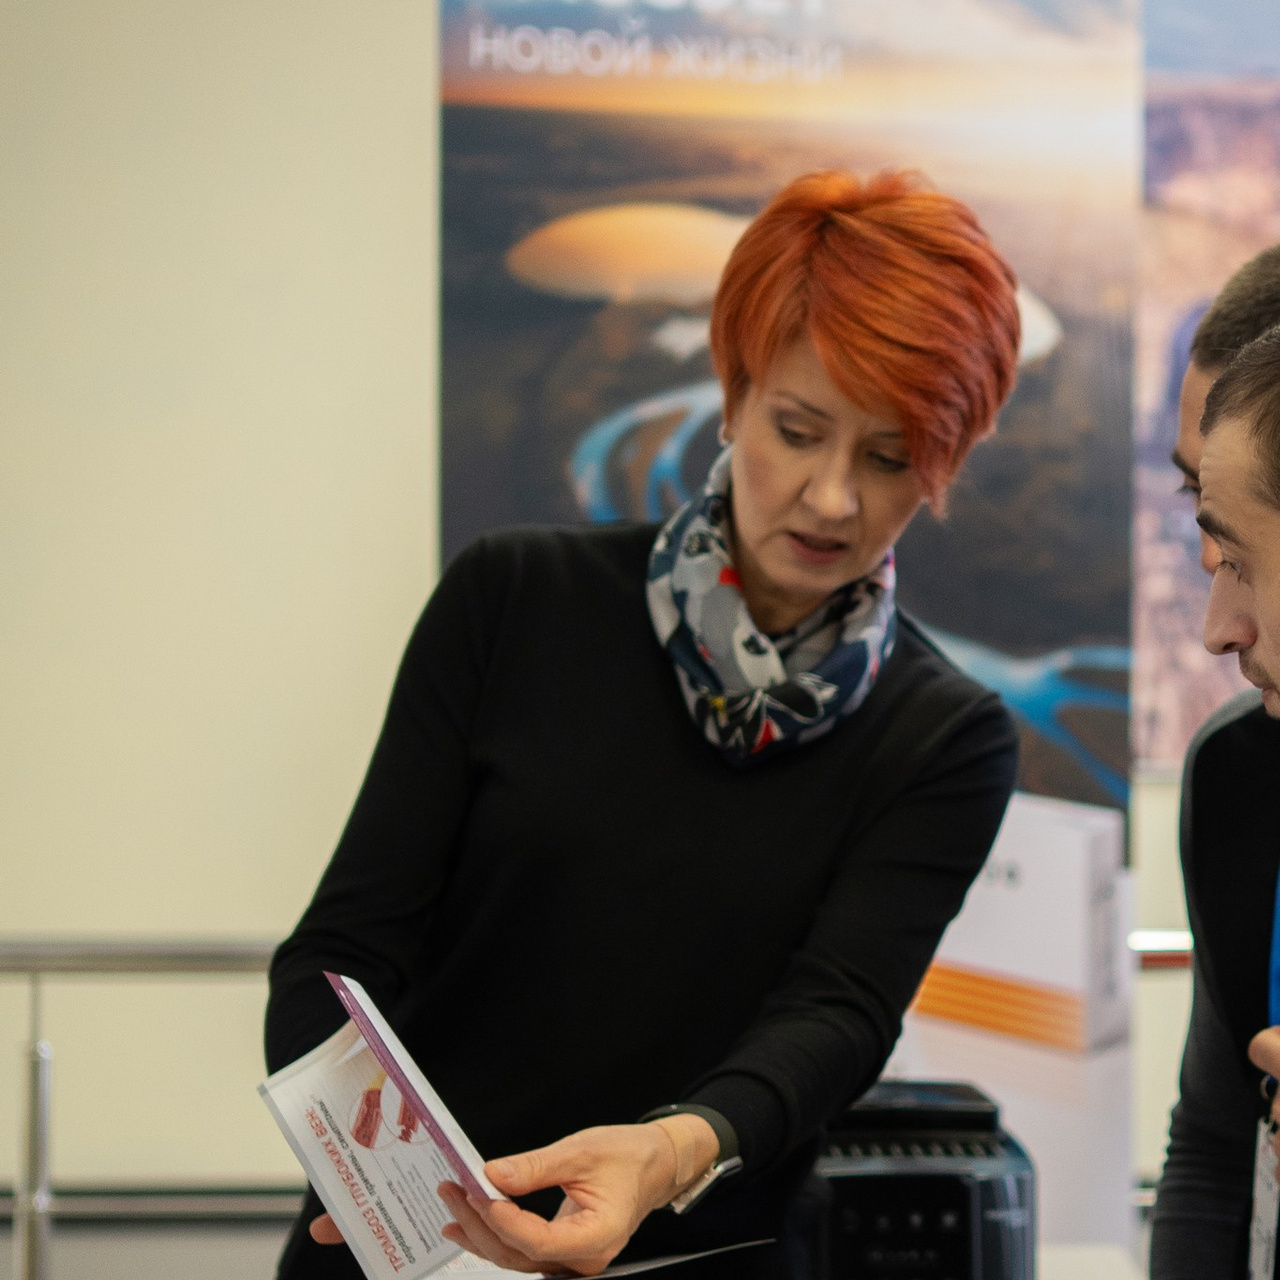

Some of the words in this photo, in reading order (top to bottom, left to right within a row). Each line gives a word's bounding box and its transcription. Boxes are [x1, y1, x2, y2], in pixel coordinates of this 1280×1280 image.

[469, 20, 651, 77] НОВОЙ
[663, 33, 845, 82] ЖИЗНИ
[361, 1206, 406, 1274] ТРОМБОЗ
